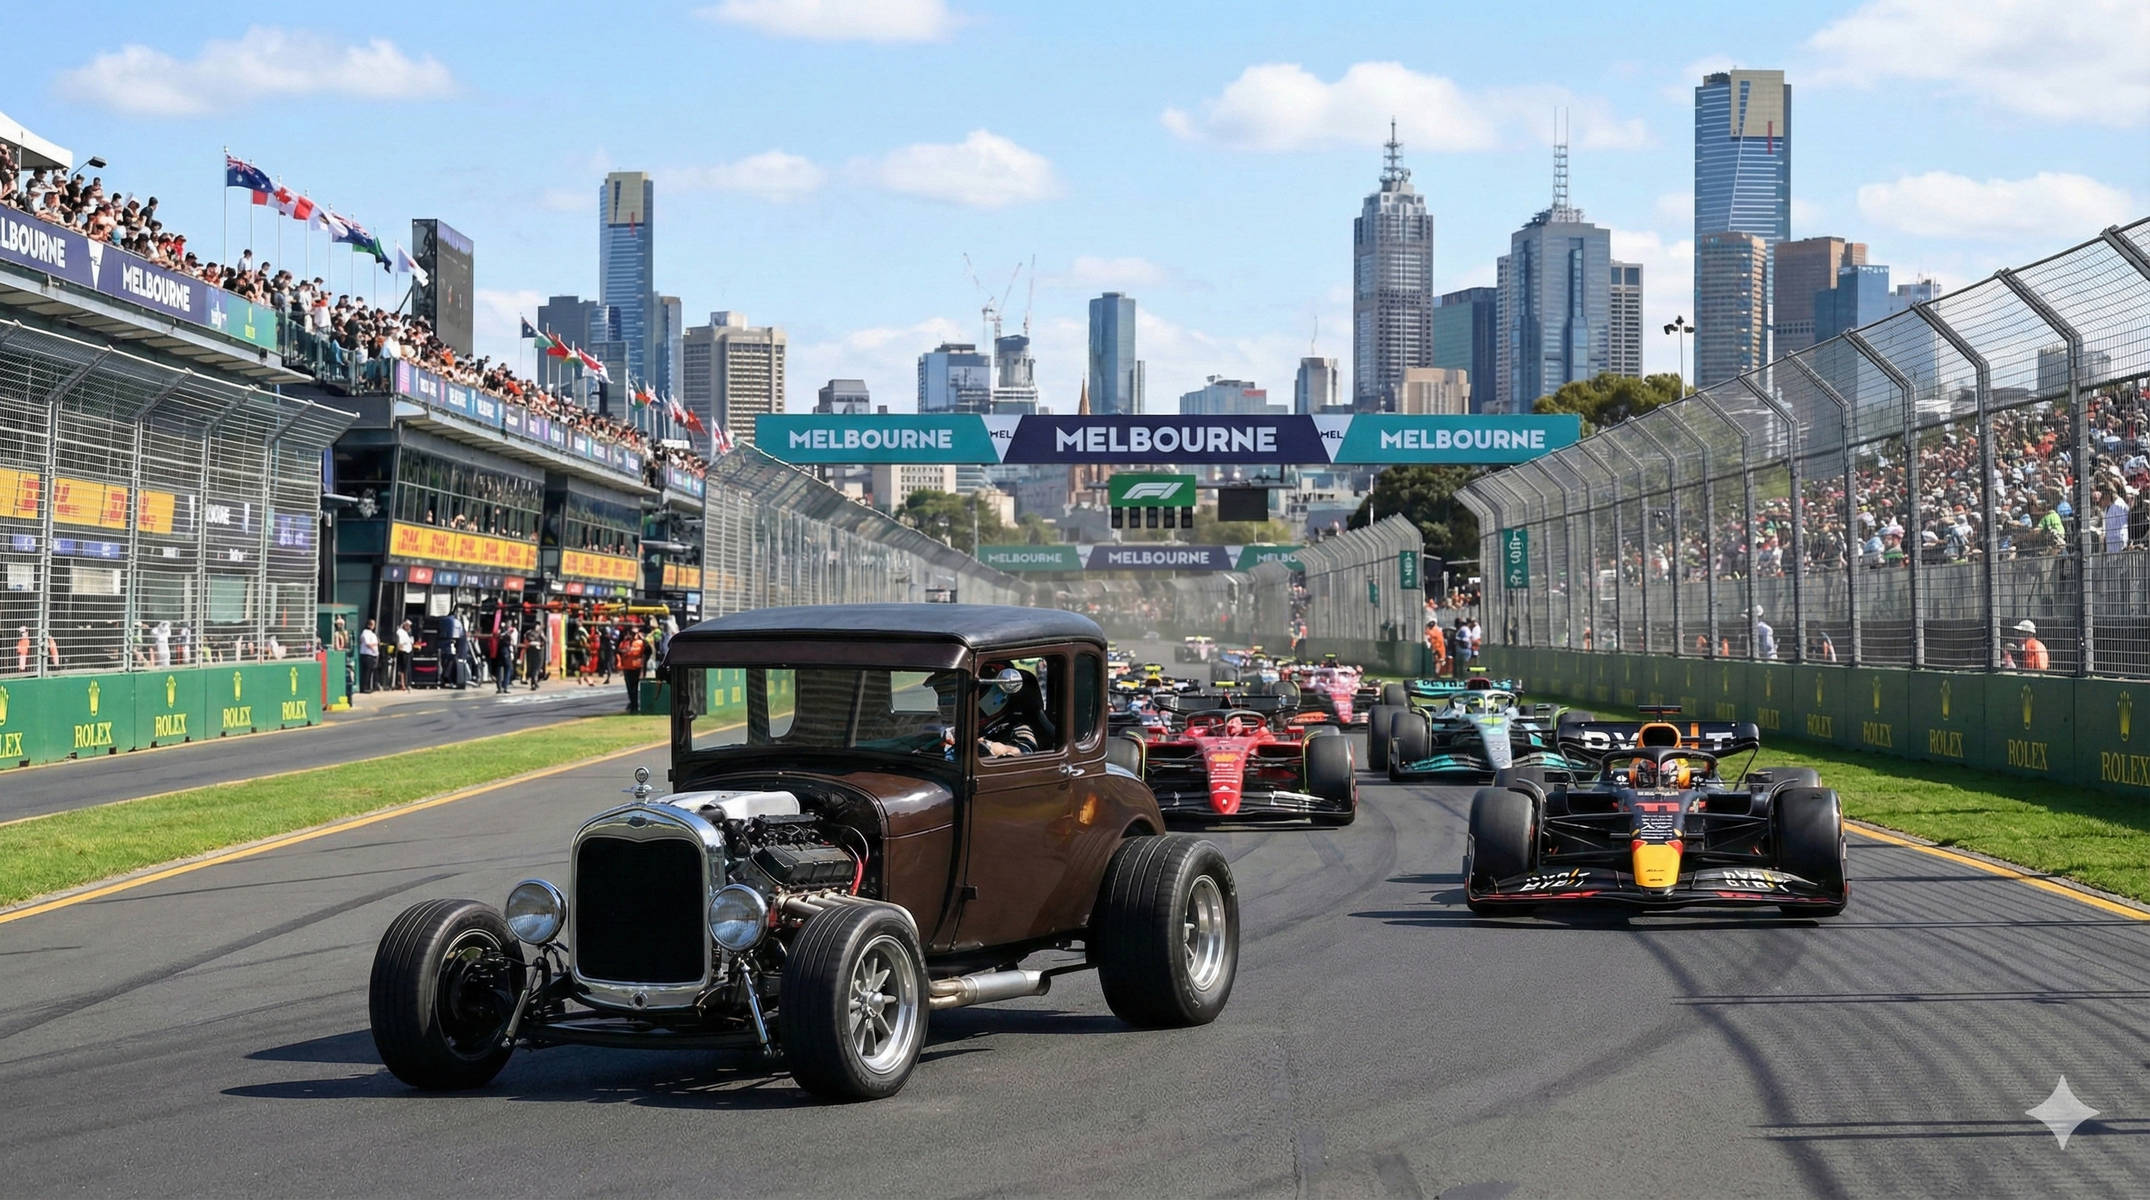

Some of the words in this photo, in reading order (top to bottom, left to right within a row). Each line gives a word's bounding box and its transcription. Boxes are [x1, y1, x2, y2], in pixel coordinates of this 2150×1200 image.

[1, 216, 66, 268] LBOURNE
[122, 261, 191, 312] MELBOURNE
[789, 429, 953, 449] MELBOURNE
[1056, 426, 1278, 452] MELBOURNE
[1381, 429, 1546, 449] MELBOURNE
[1108, 552, 1210, 565] MELBOURNE
[223, 706, 252, 729] ROLEX
[282, 700, 308, 720] ROLEX
[74, 721, 112, 748] ROLEX
[155, 713, 187, 737] ROLEX
[1863, 721, 1892, 748] ROLEX
[1929, 729, 1964, 758] ROLEX
[2007, 739, 2048, 771] ROLEX
[2101, 751, 2150, 787] ROLEX
